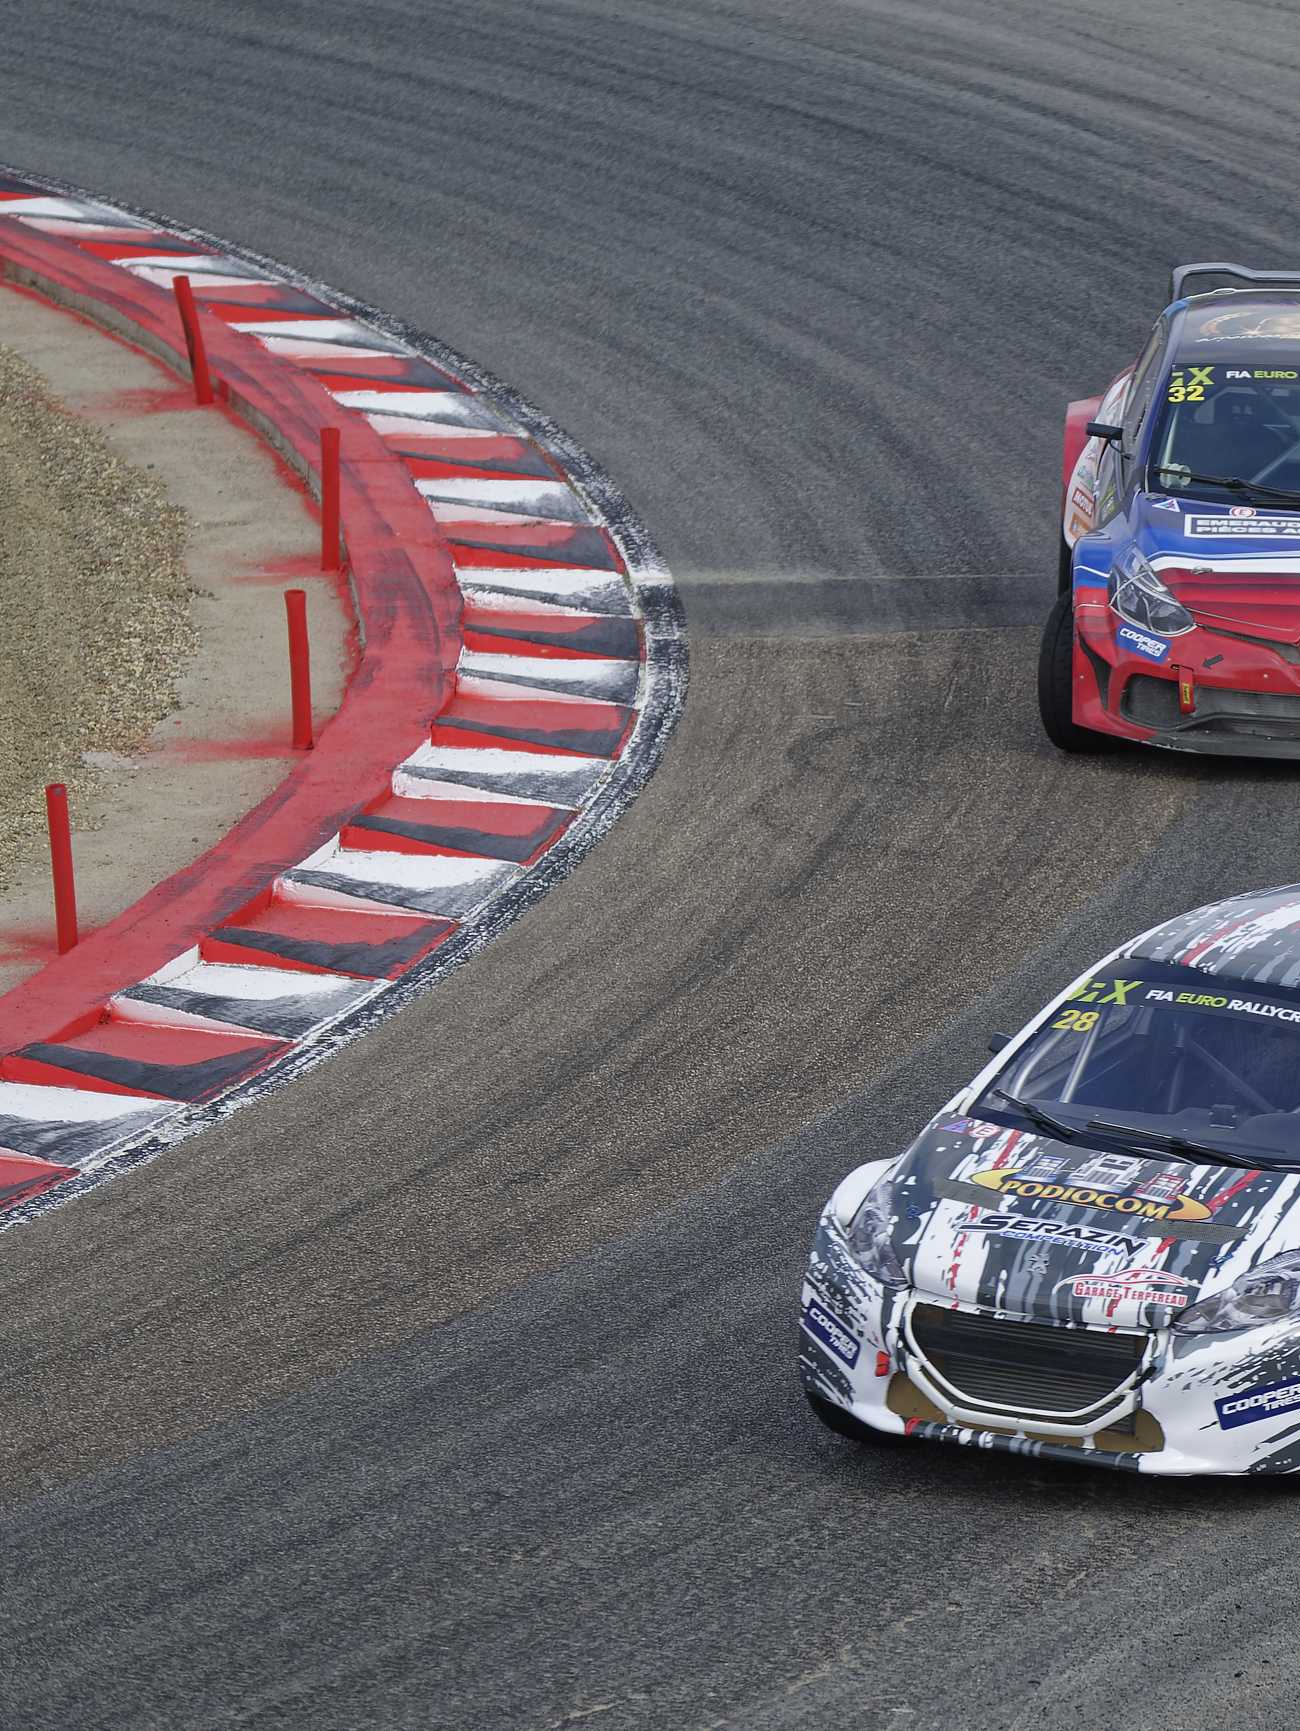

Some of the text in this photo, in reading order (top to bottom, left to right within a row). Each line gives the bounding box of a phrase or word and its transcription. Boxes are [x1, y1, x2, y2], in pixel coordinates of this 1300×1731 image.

[1226, 370, 1251, 378] FIA
[1254, 370, 1298, 379] EURO
[1168, 385, 1205, 402] 32
[1120, 628, 1167, 652] COOPER
[1145, 989, 1174, 1002] FIA
[1175, 992, 1228, 1008] EURO
[1052, 1009, 1100, 1032] 28
[1000, 1179, 1172, 1221] PODIOCOM
[957, 1215, 1145, 1256] SERAZIN
[1000, 1230, 1123, 1255] COMPETITION
[1075, 1282, 1188, 1306] GARAGE TERPEREAU
[809, 1307, 858, 1354] COOPER
